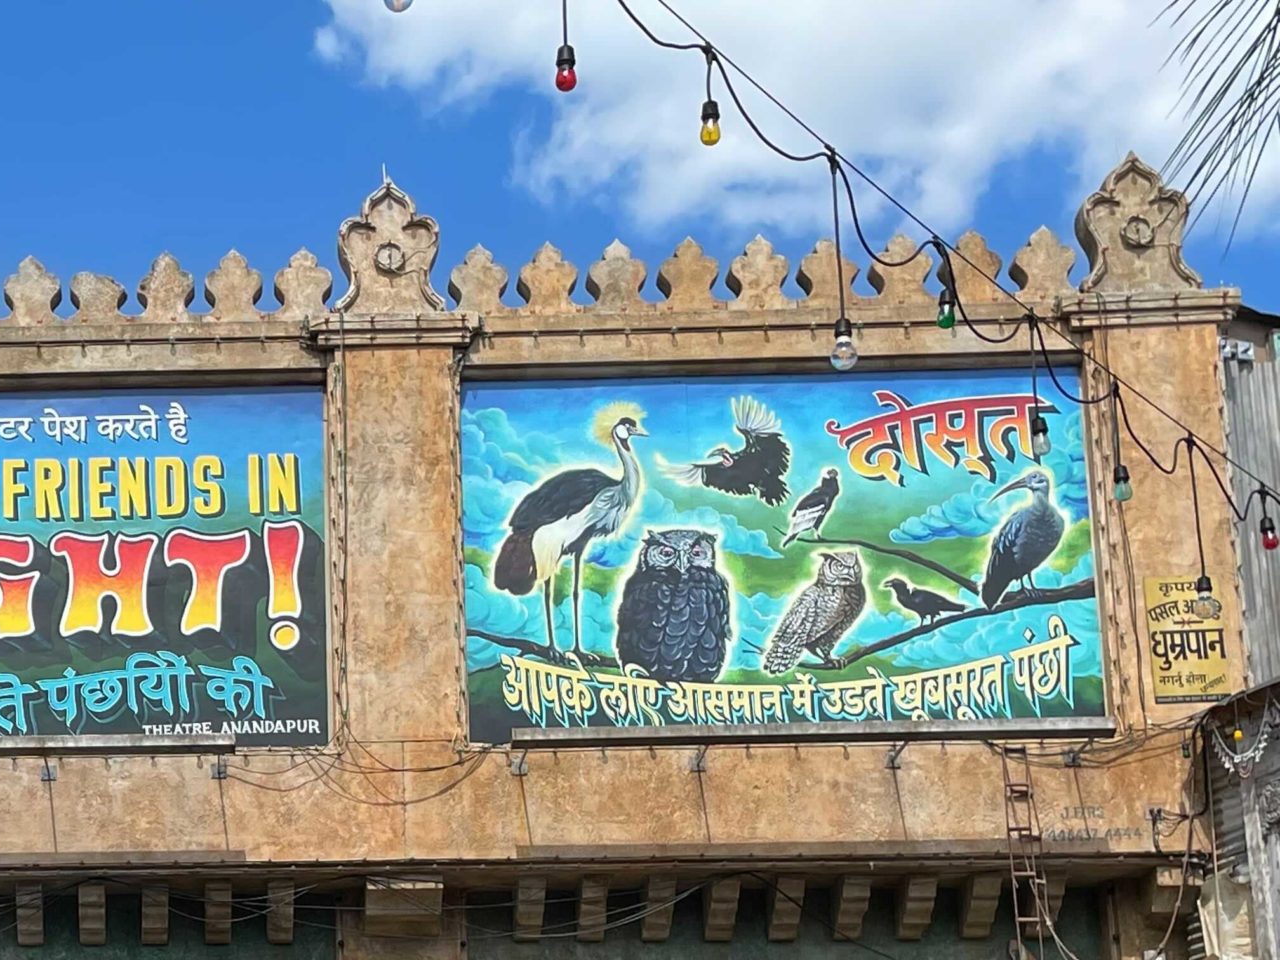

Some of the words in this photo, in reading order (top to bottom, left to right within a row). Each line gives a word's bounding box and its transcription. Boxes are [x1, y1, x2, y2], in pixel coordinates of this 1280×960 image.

[40, 407, 88, 443] पेश
[95, 405, 159, 442] करते
[166, 402, 189, 443] है
[2, 455, 224, 520] FRIENDS
[247, 453, 304, 517] IN
[198, 655, 275, 720] की
[499, 651, 592, 719] आपके
[1009, 614, 1078, 702] पंछी
[142, 721, 212, 735] THEATRE
[221, 719, 321, 735] ANANDAPUR
